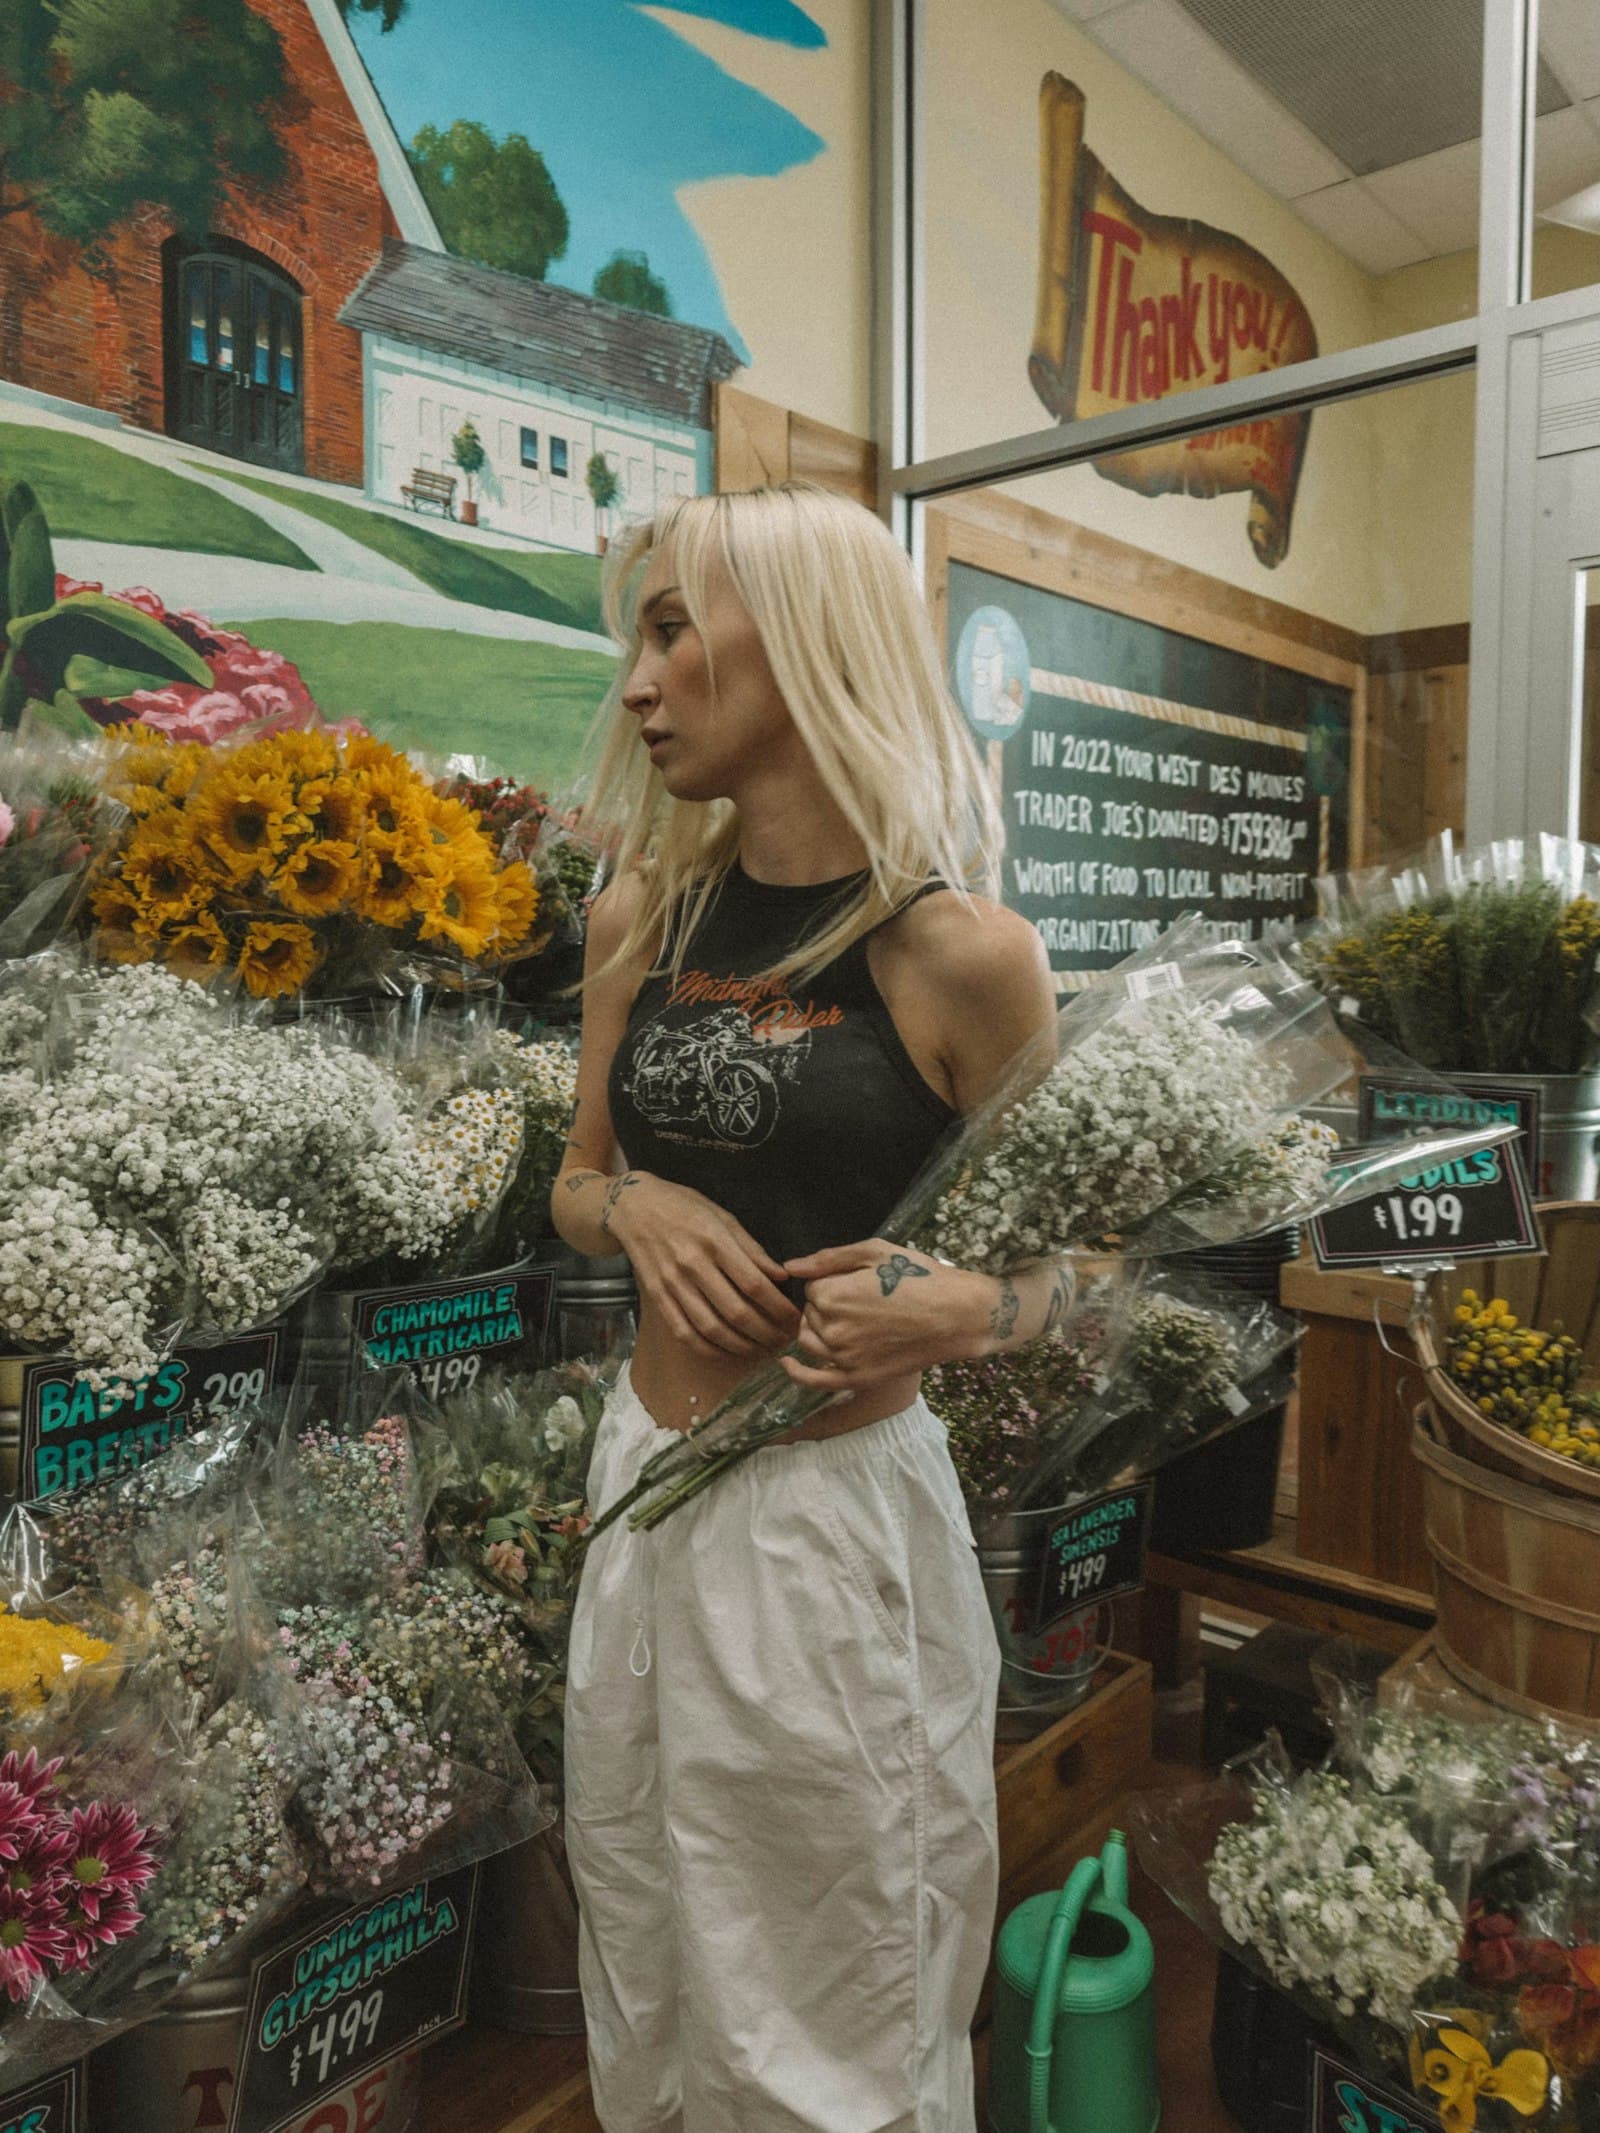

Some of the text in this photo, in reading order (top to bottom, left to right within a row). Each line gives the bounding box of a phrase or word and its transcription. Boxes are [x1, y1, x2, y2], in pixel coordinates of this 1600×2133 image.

[1083, 210, 1206, 403] Thank
[1032, 730, 1305, 803] IN 2022 YOUR WEST DES MOINES
[1014, 790, 1093, 834] TRADER
[1101, 801, 1145, 840] JOE'S
[1148, 808, 1220, 846] DONATED
[1014, 857, 1307, 901] WORTH OF FOOD TO LOCAL NON-PROFIT
[751, 999, 844, 1036] Rider
[1374, 1091, 1520, 1124] LEPIDIUM
[1373, 1192, 1464, 1241] $1.99
[375, 1282, 515, 1335] CHAMOMILE
[366, 1312, 523, 1370] MATRICARIA
[1072, 1498, 1137, 1539] LAVENDER
[1059, 1553, 1107, 1599] $4.99
[296, 1883, 424, 1984] UNICORN
[263, 1903, 454, 2045] GYPSOPHILA
[290, 1989, 384, 2087] $4.99
